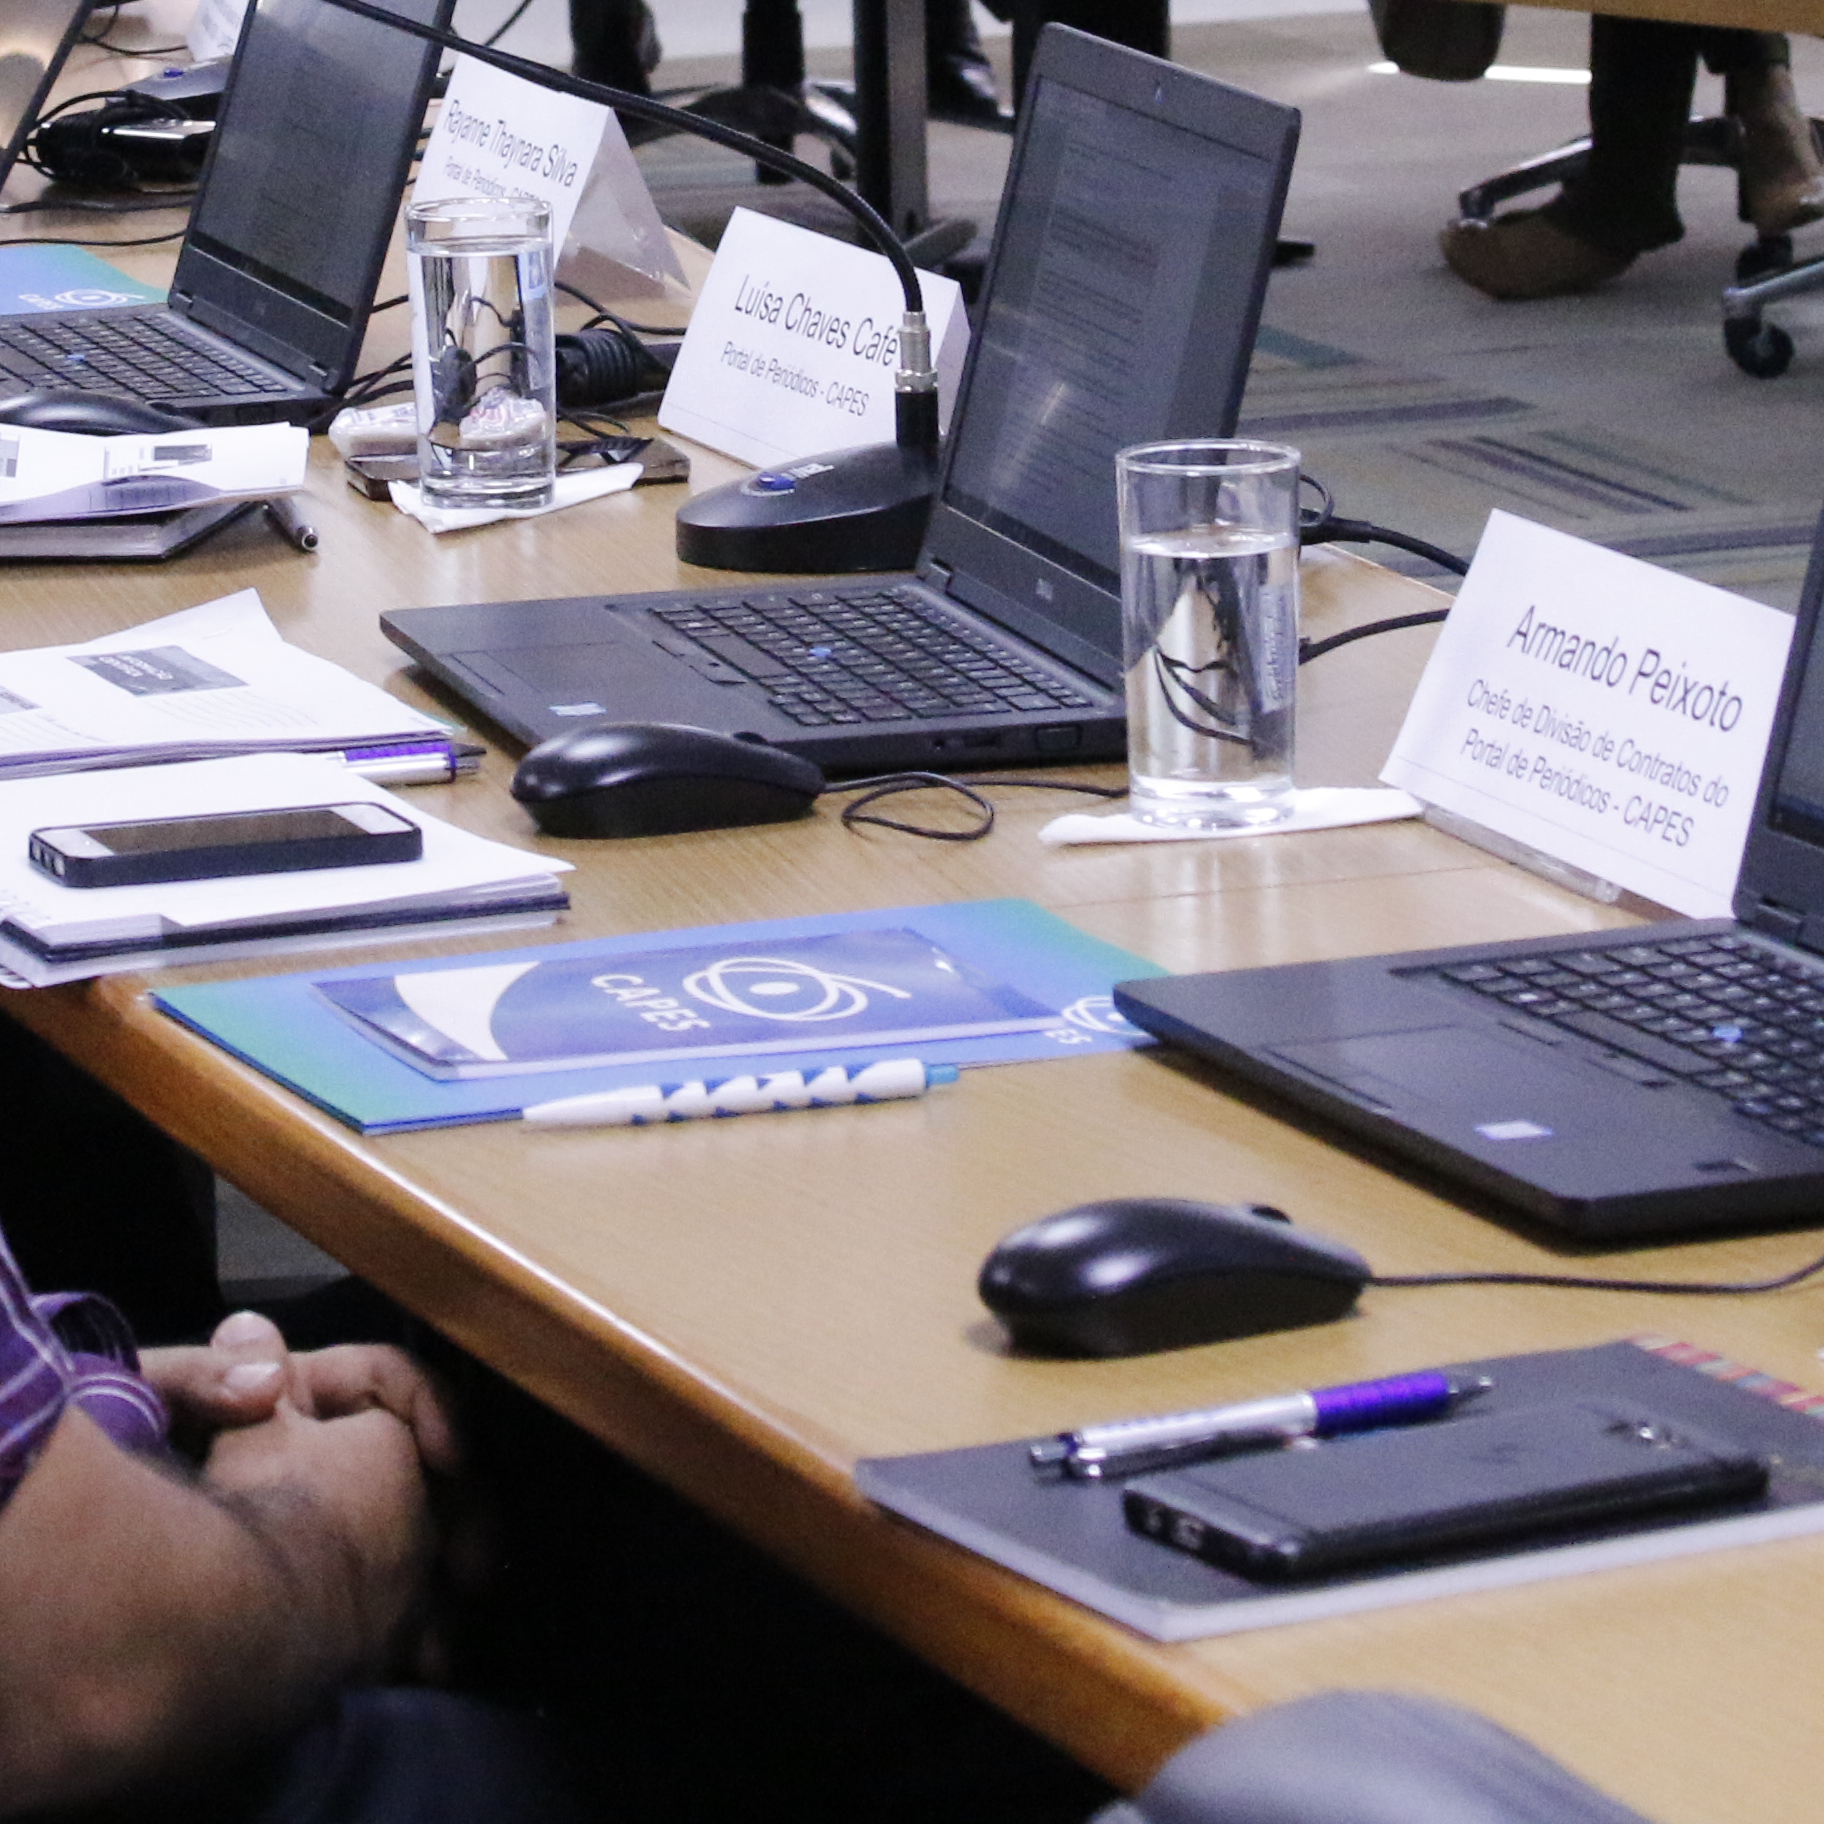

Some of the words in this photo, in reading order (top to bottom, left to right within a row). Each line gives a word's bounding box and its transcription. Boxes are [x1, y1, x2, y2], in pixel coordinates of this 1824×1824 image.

[490, 119, 545, 170] Thaynara
[542, 143, 578, 188] Silva
[734, 274, 784, 324] Luísa
[784, 292, 851, 349] Chaves
[721, 340, 753, 371] Portal
[750, 354, 767, 377] de
[764, 358, 820, 398] Periódicos
[825, 381, 870, 417] CAPES
[1505, 604, 1629, 688] Armando
[1627, 647, 1744, 733] Peixoto
[1466, 678, 1512, 720] Chefe
[1511, 696, 1534, 729] de
[1533, 703, 1592, 753] Divisão
[1591, 731, 1616, 762] de
[1616, 737, 1703, 798] Contratos
[1702, 774, 1730, 809] do
[1460, 727, 1511, 770] Portal
[1505, 748, 1529, 780] de
[1527, 754, 1612, 815] Periódicos
[1622, 794, 1695, 848] CAPES
[590, 973, 711, 1033] CAPES
